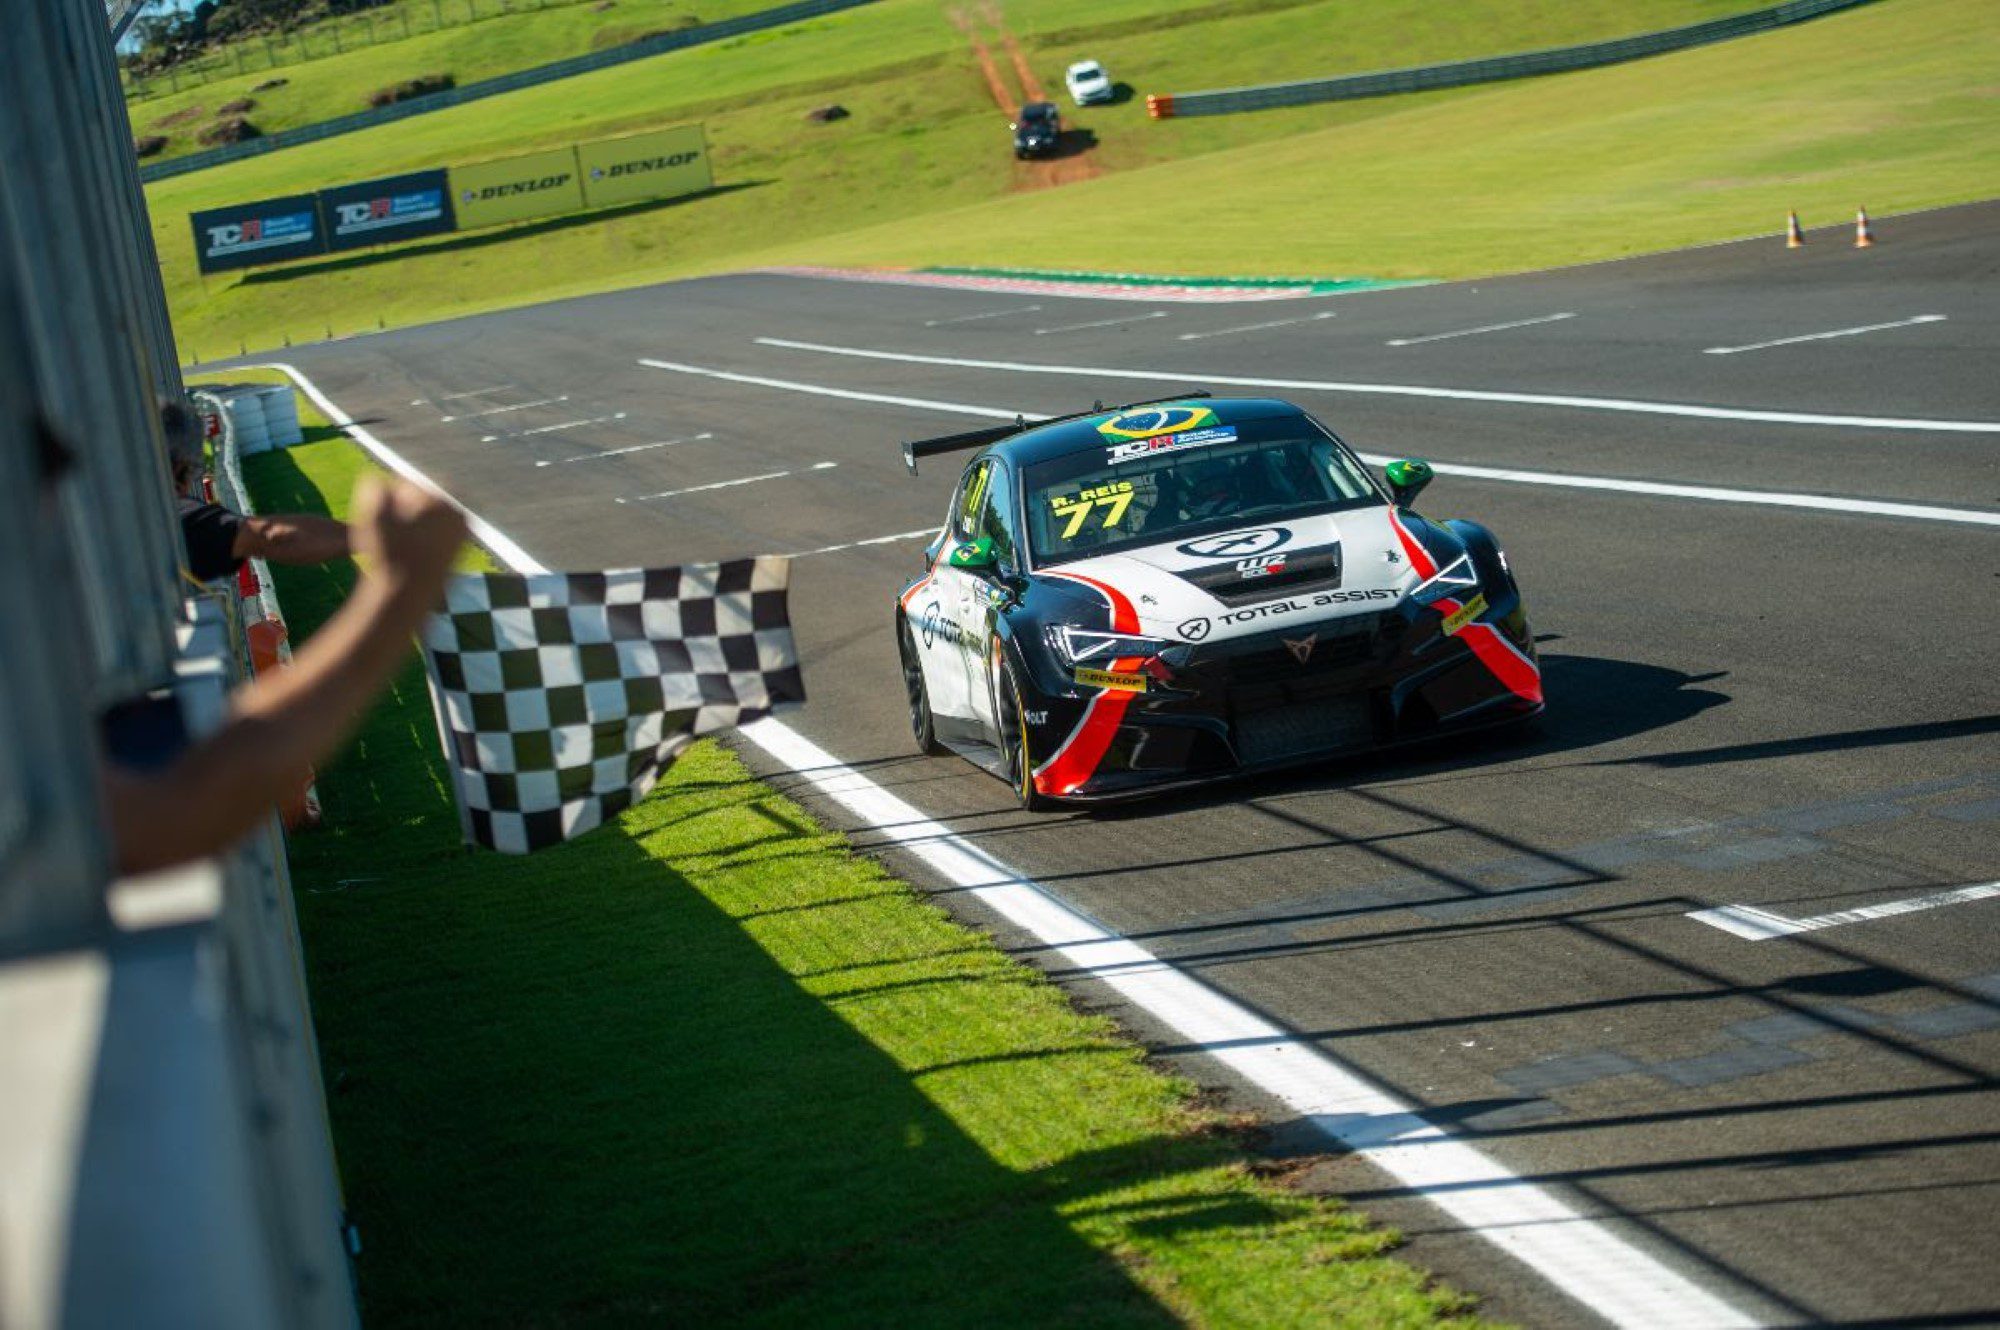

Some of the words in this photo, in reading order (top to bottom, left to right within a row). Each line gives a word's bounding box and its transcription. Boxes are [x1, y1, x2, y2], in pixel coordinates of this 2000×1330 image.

[607, 151, 700, 178] DUNLOP
[480, 173, 571, 200] DUNLOP
[335, 197, 392, 226] TCR
[207, 219, 262, 248] TCR
[1051, 497, 1075, 509] R.
[1080, 482, 1133, 501] REIS
[1054, 490, 1134, 539] 77
